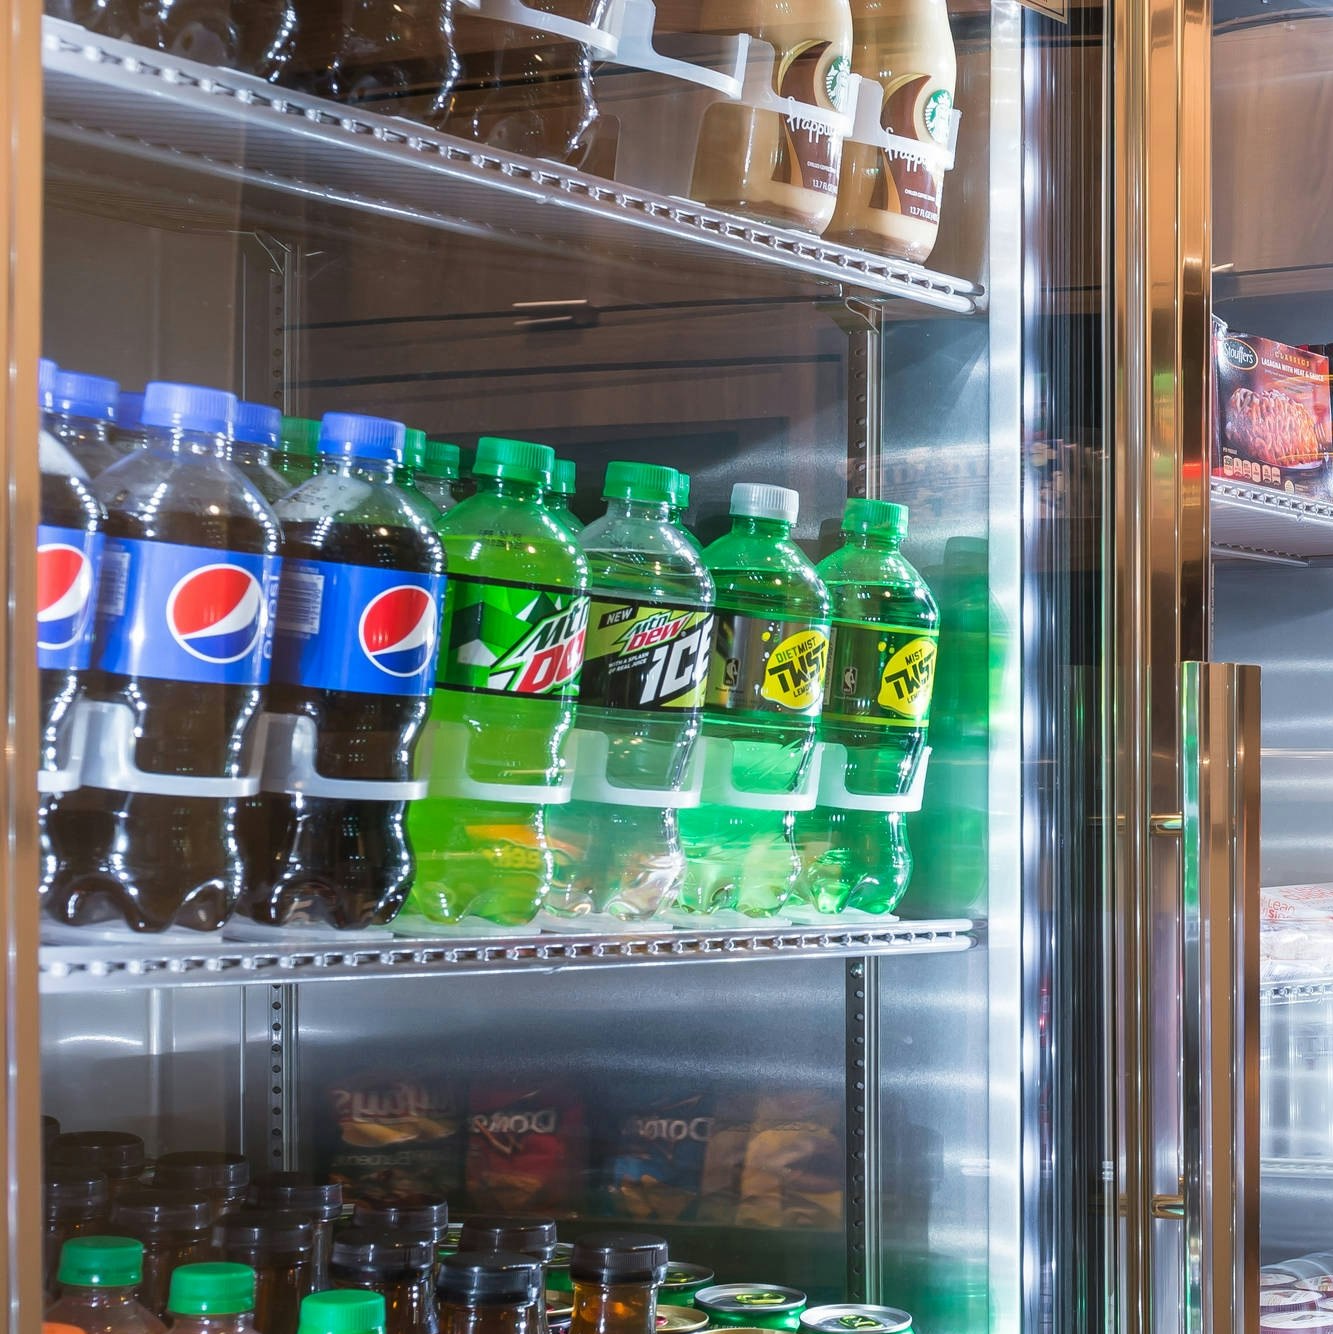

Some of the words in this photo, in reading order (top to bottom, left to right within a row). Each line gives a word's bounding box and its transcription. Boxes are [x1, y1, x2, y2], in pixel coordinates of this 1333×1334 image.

[606, 607, 635, 626] NEW
[775, 647, 798, 664] DIET
[798, 637, 817, 655] MIST
[905, 648, 924, 665] MIST
